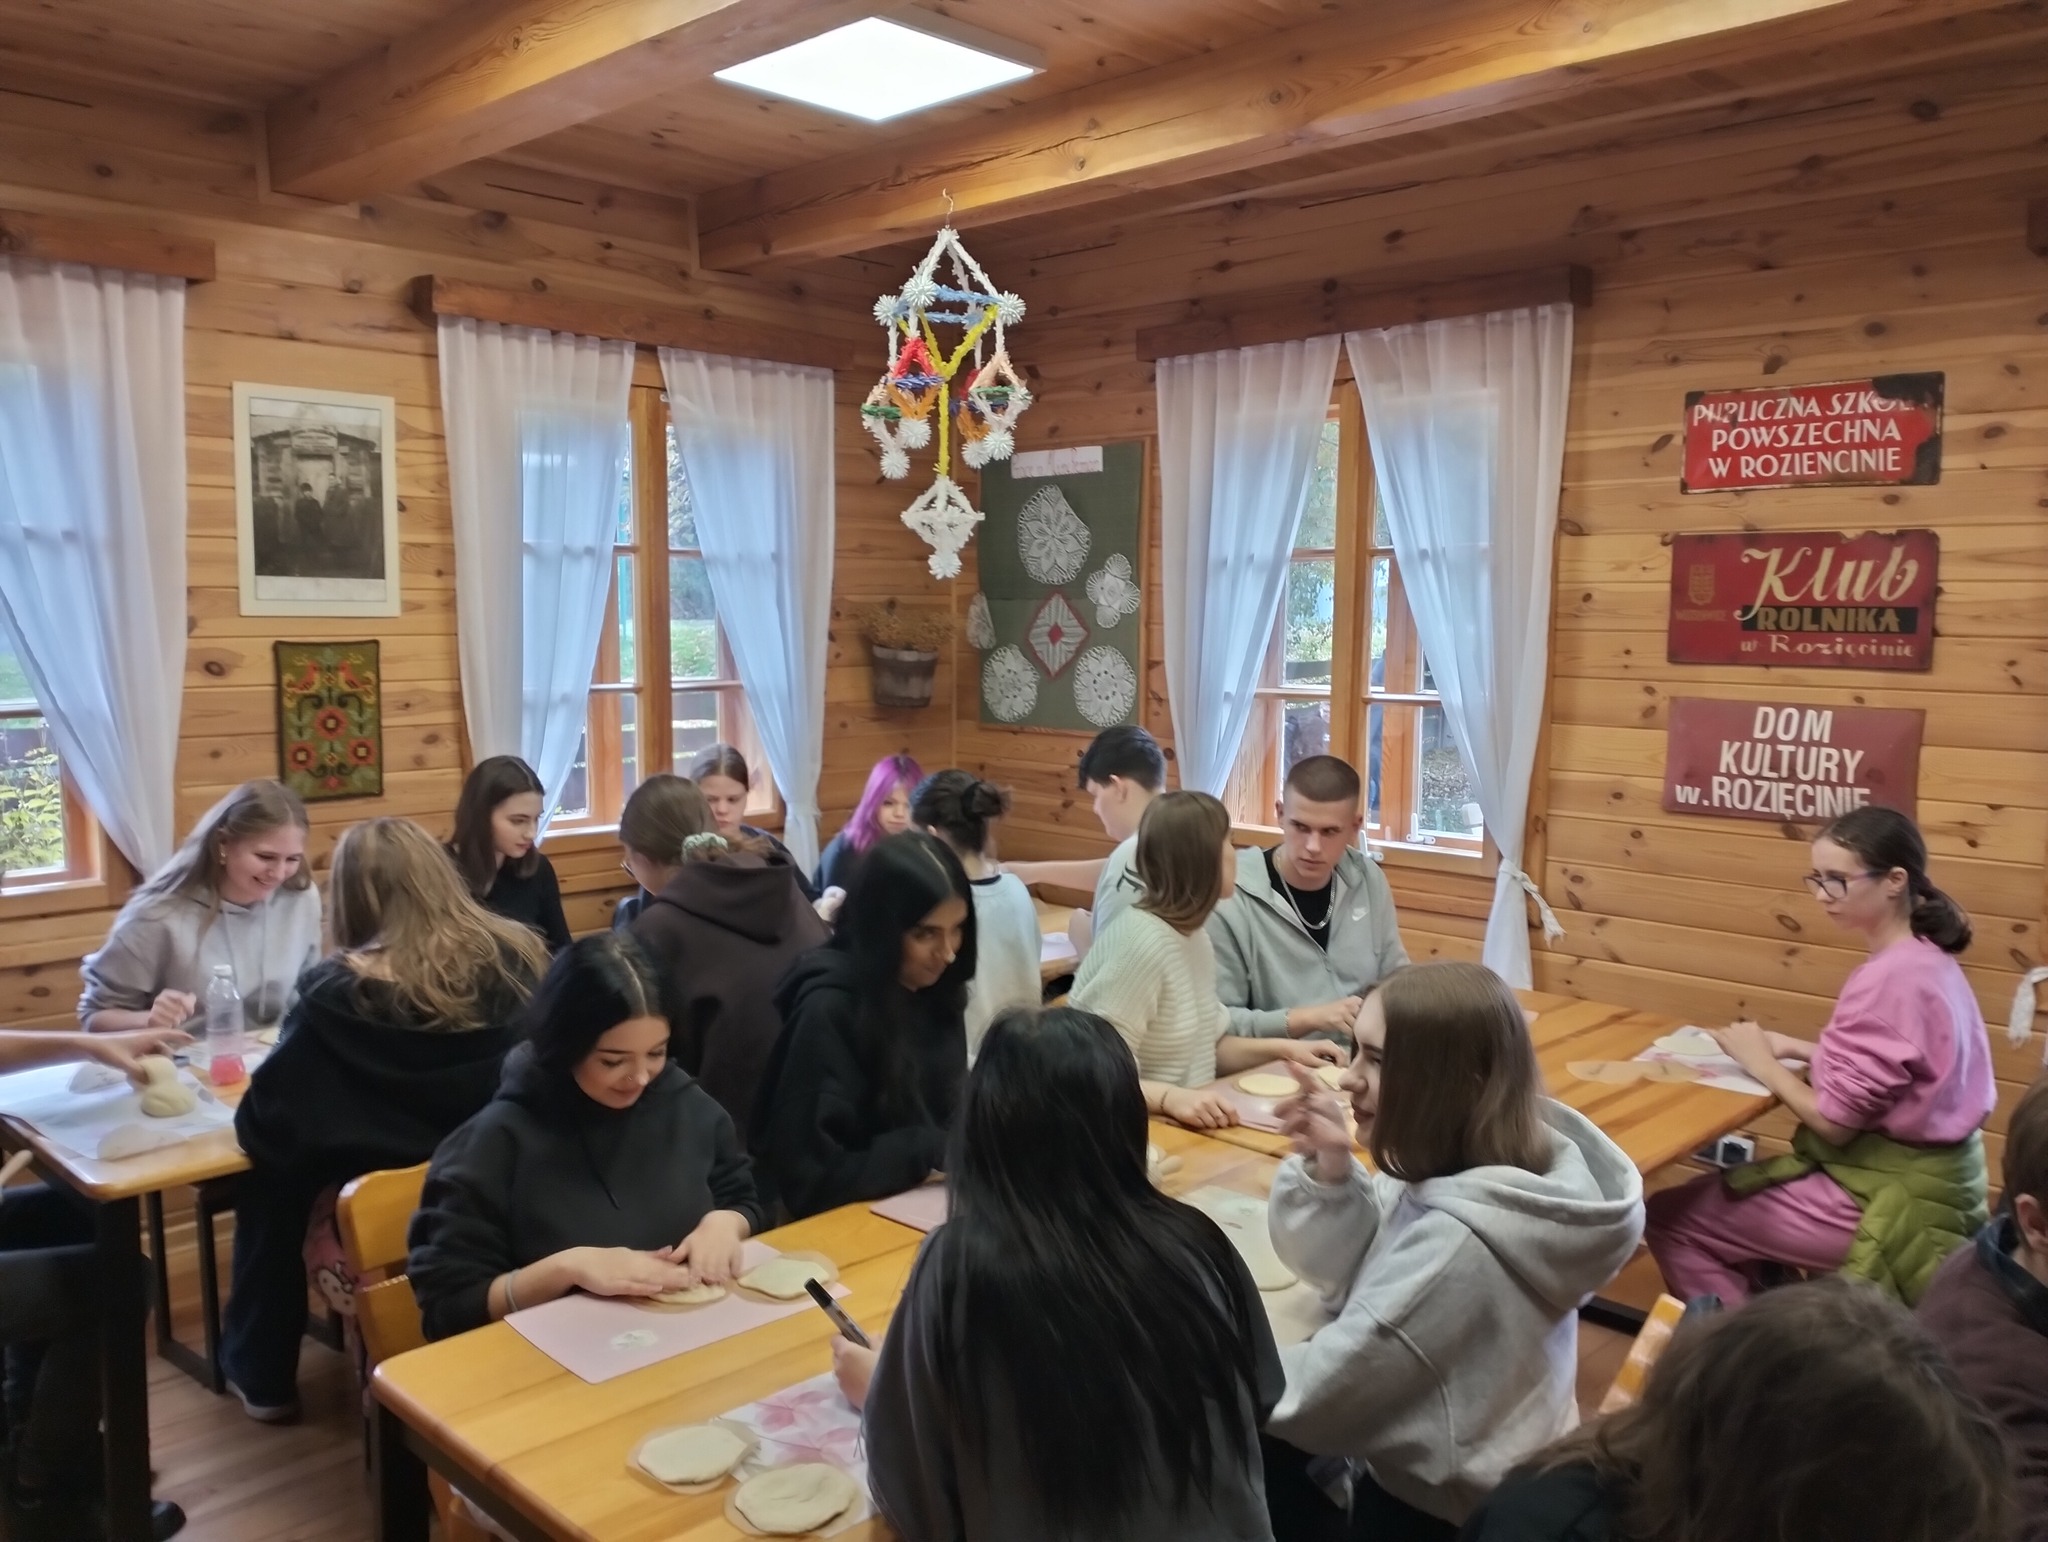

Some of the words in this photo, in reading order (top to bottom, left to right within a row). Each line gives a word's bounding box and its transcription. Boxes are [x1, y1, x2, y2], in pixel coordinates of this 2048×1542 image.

[1712, 418, 1902, 451] POWSZECHNA
[1708, 457, 1732, 478] W
[1740, 447, 1902, 478] ROZIENCINIE
[1733, 544, 1919, 620] Klub
[1756, 606, 1900, 632] ROLNIKA
[1741, 638, 1758, 652] w
[1753, 706, 1833, 743] DOM
[1719, 740, 1865, 784] KULTURY
